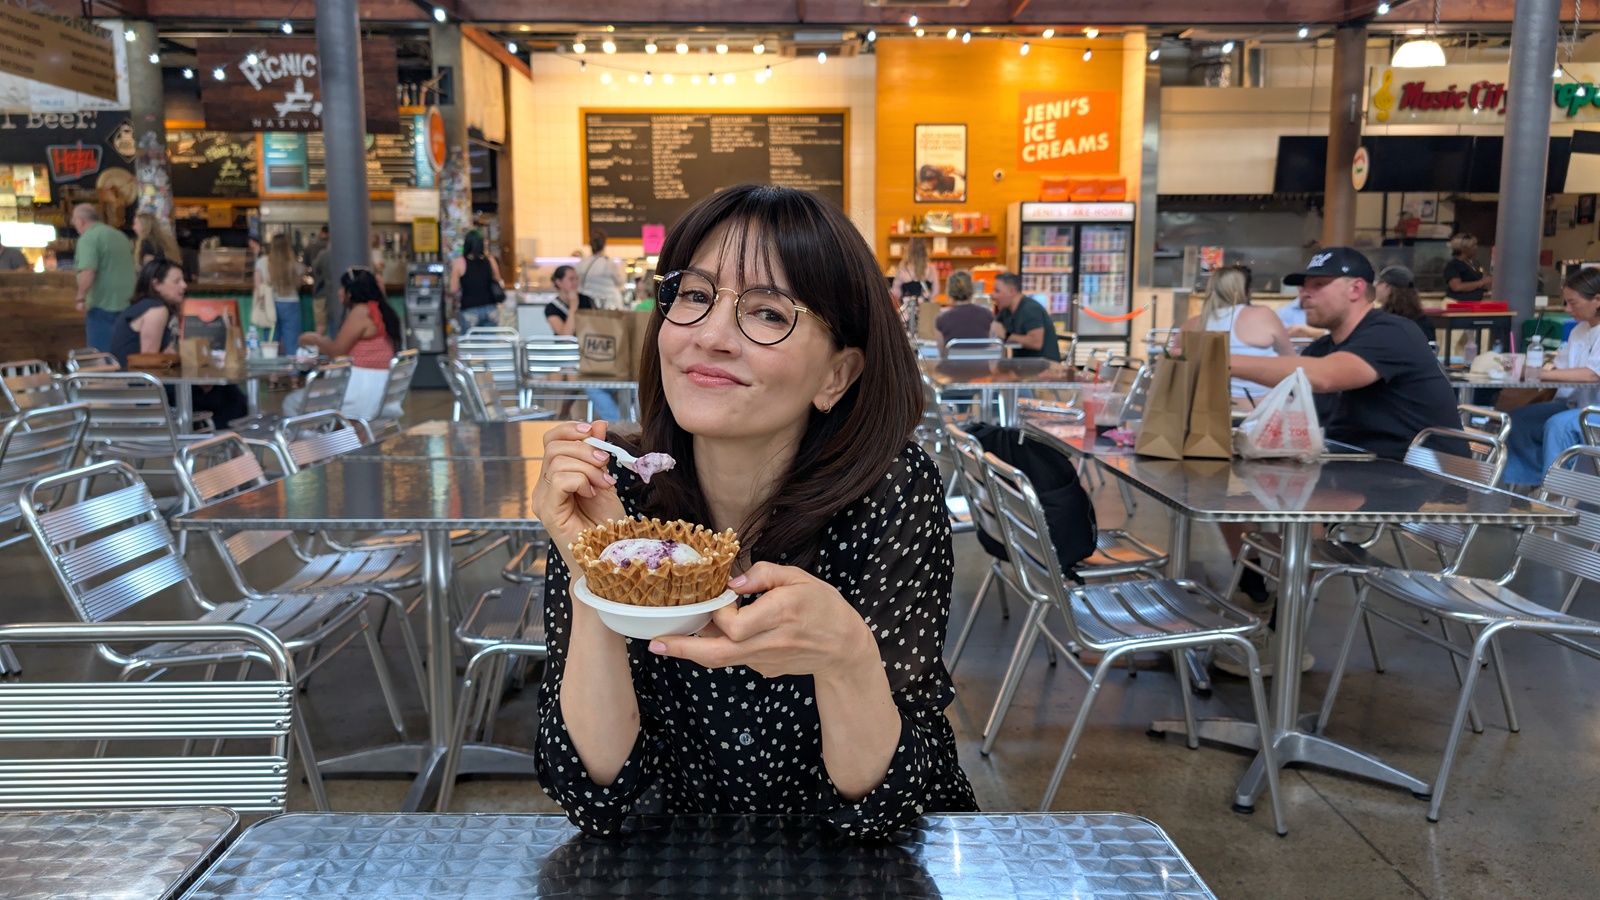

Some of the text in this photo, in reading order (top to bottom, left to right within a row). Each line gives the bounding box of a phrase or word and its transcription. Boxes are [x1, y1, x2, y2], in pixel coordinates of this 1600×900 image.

[1399, 82, 1467, 111] Music
[1023, 97, 1090, 124] JENI'S
[252, 118, 320, 129] NASHVI
[1024, 121, 1056, 144] ICE
[1022, 132, 1109, 162] CREAMS
[1032, 208, 1124, 217] JENI'S TAKE HOME
